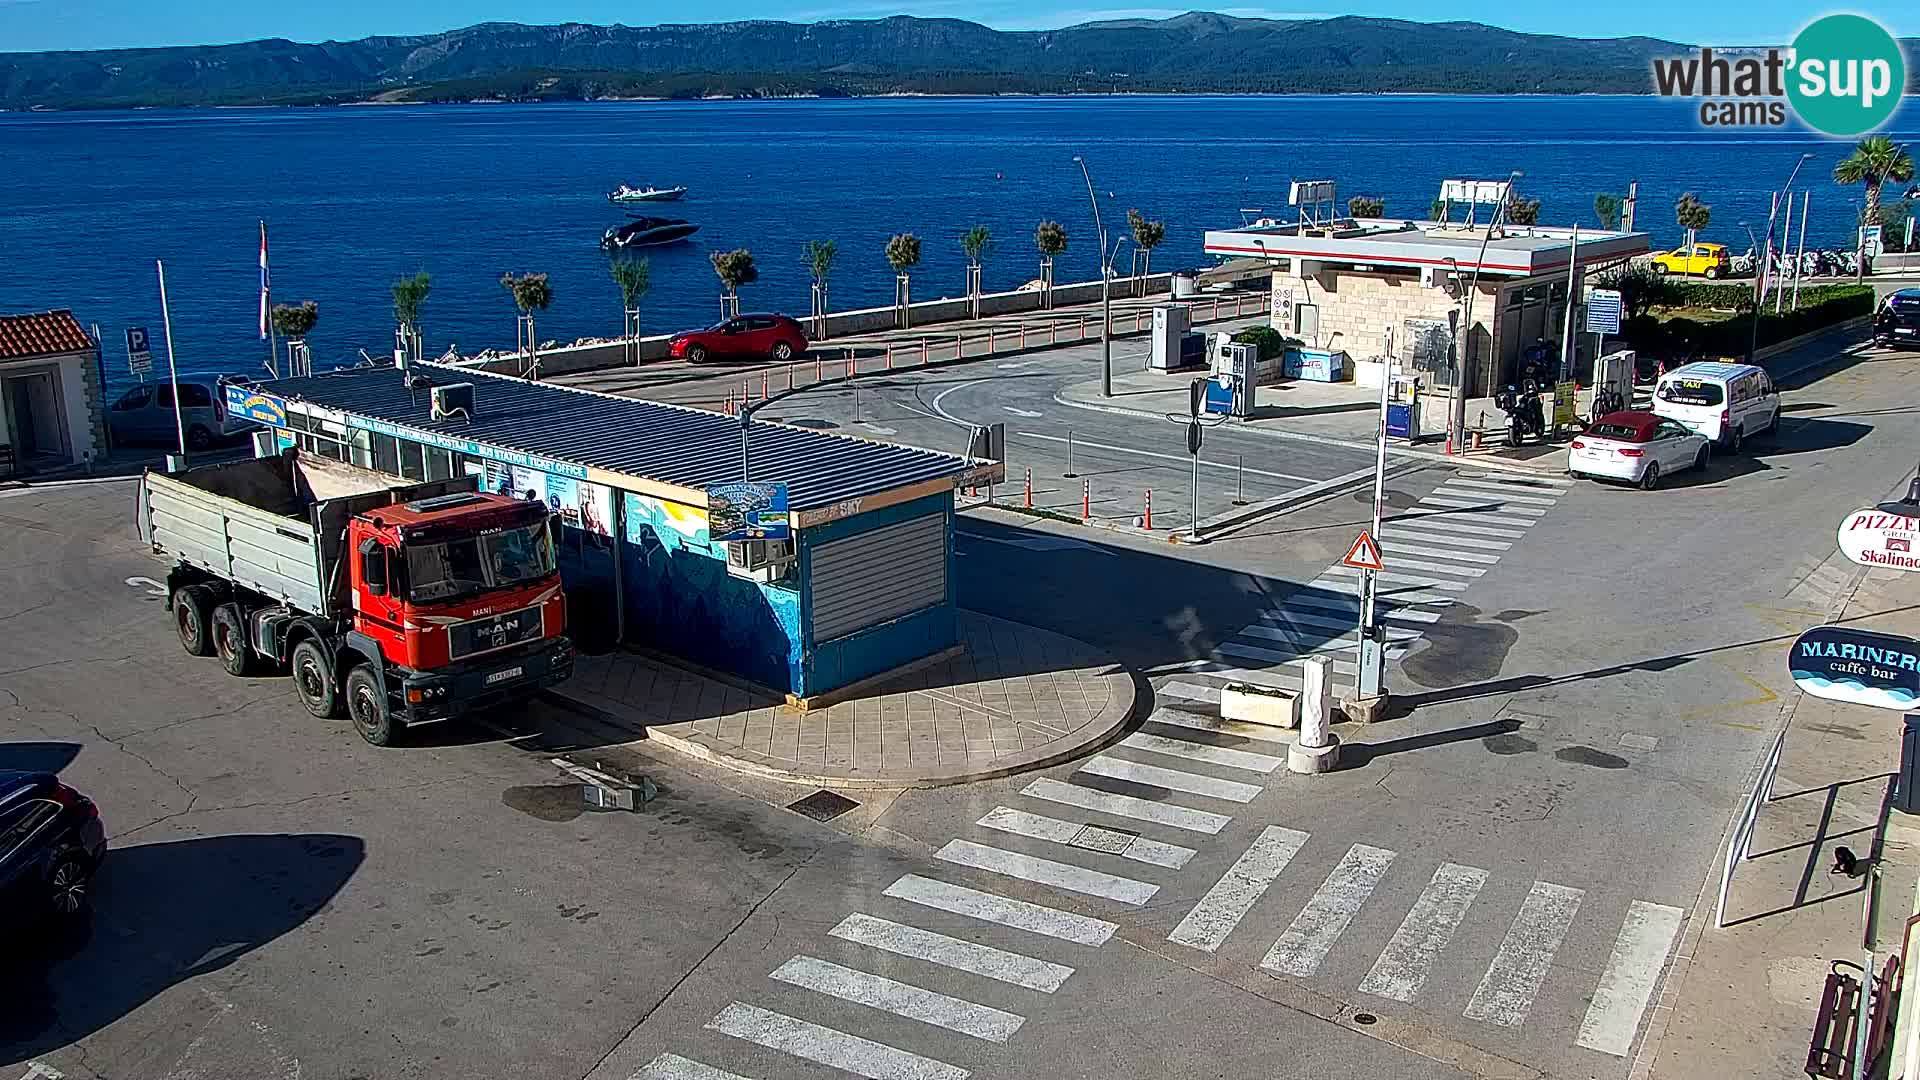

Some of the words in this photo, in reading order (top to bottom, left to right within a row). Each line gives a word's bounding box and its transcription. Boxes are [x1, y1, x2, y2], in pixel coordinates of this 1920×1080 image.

[131, 331, 144, 349] P
[1682, 380, 1701, 389] TAXI
[438, 436, 468, 452] POSTAJA
[480, 446, 493, 457] BUS
[494, 449, 527, 464] STATION
[529, 455, 554, 470] TICKET
[556, 461, 584, 476] OFFICE
[480, 527, 502, 535] MAN
[1851, 515, 1920, 532] PIZZE
[1882, 530, 1918, 540] GRILL
[1830, 661, 1866, 675] caffe
[1871, 665, 1898, 680] bar
